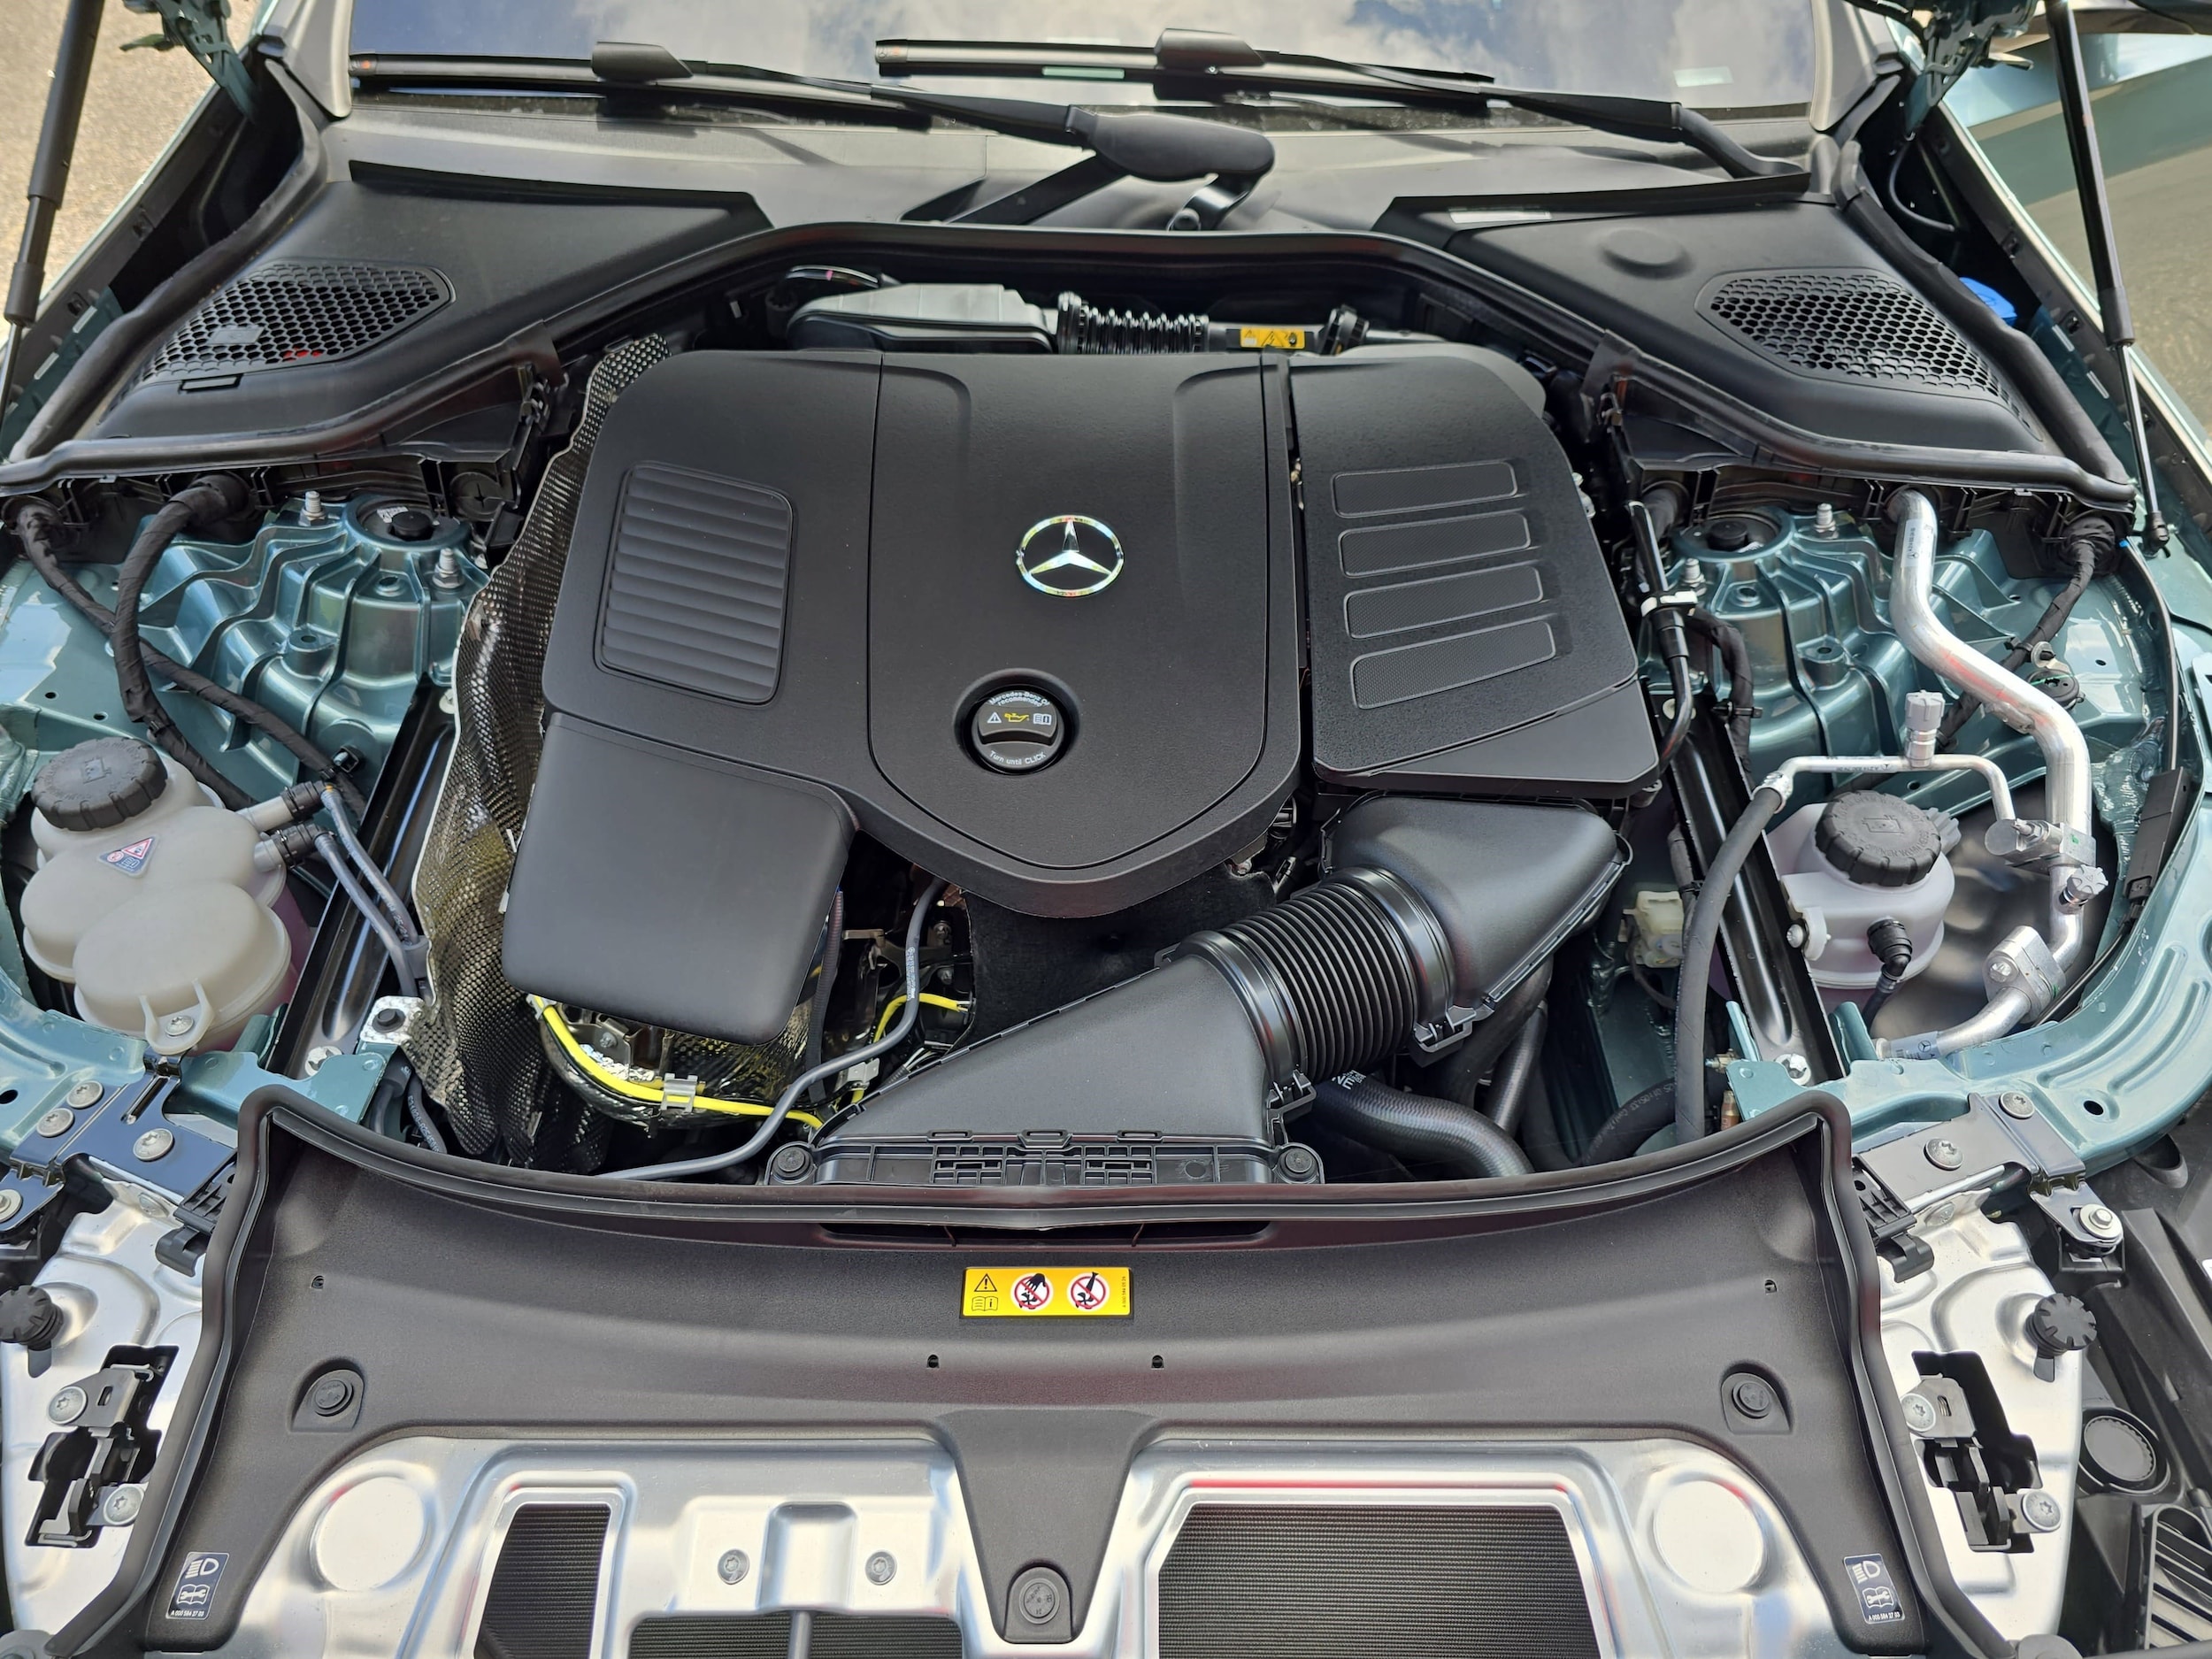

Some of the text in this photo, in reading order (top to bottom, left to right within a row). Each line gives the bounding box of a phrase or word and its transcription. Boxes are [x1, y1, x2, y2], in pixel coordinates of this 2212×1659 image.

[989, 691, 1041, 705] Mercedes-Benz
[998, 696, 1042, 707] recommended
[990, 750, 1004, 763] Turn
[1025, 751, 1046, 764] CLICK
